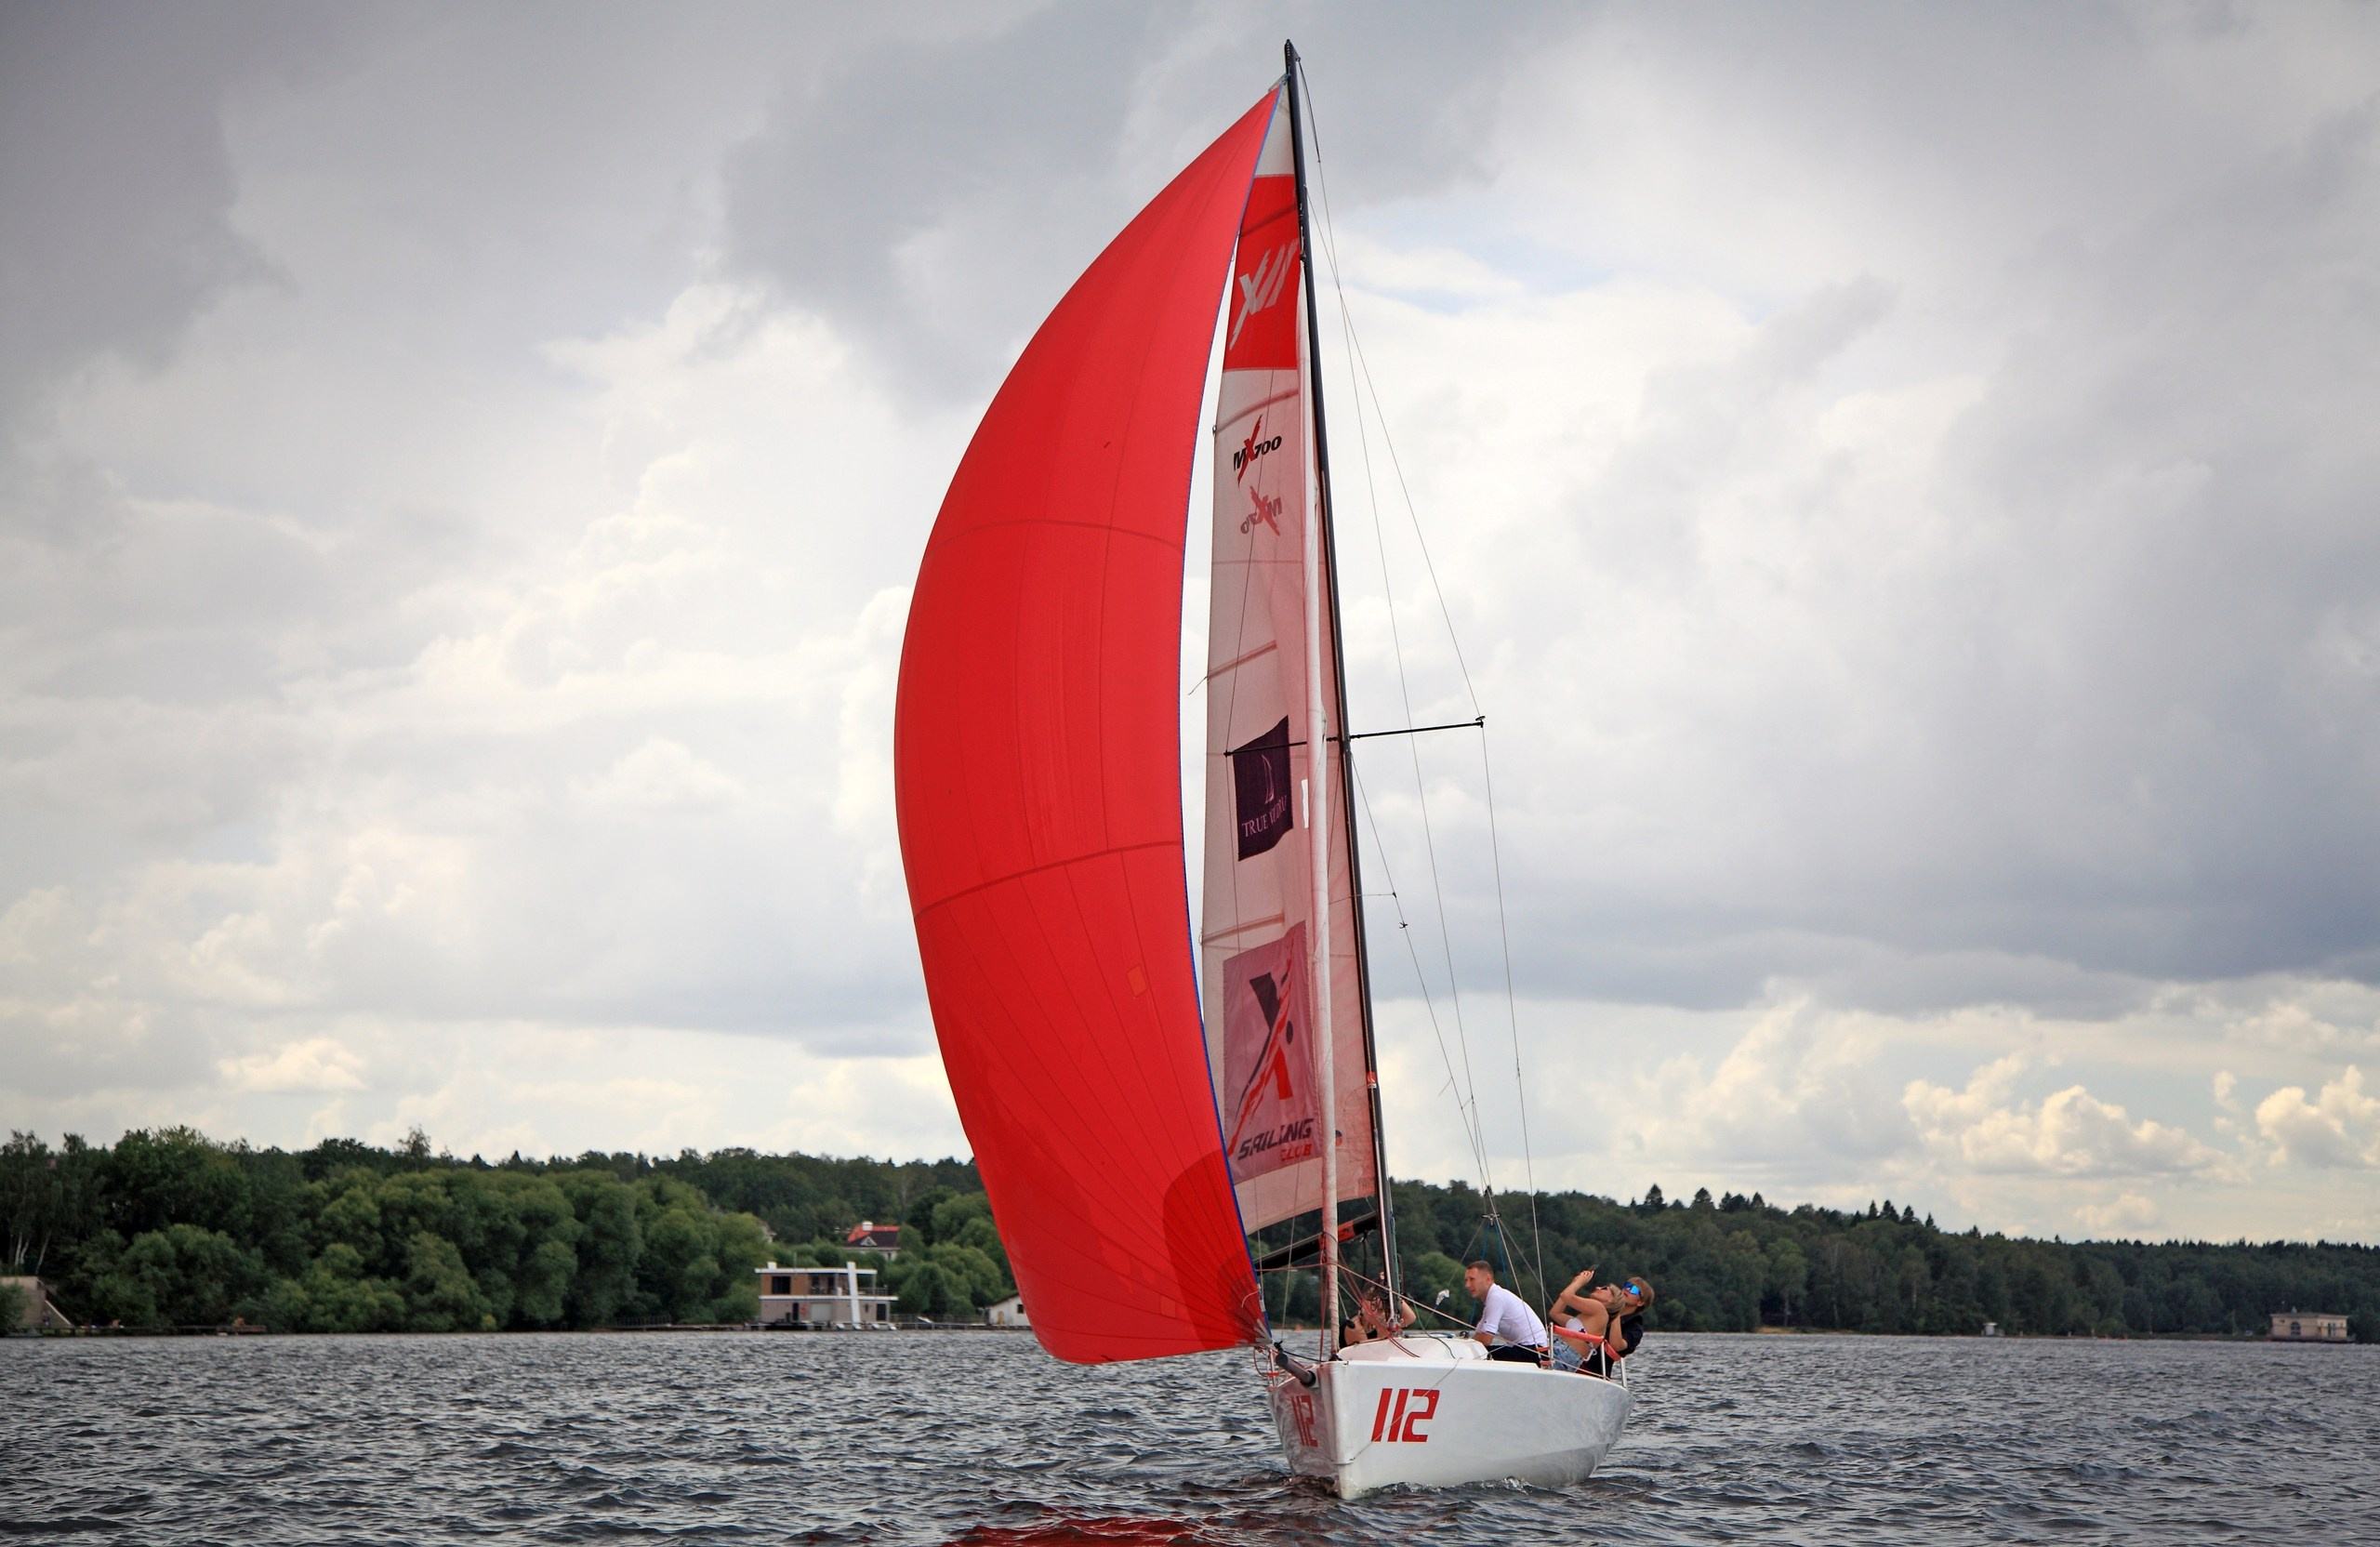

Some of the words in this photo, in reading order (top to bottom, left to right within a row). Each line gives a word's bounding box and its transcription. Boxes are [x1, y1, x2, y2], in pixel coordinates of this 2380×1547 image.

[1241, 814, 1268, 838] TRUE
[1237, 1118, 1315, 1161] SAILING
[1280, 1144, 1312, 1161] CLUB
[1290, 1395, 1318, 1448] 112
[1370, 1388, 1440, 1443] 112
